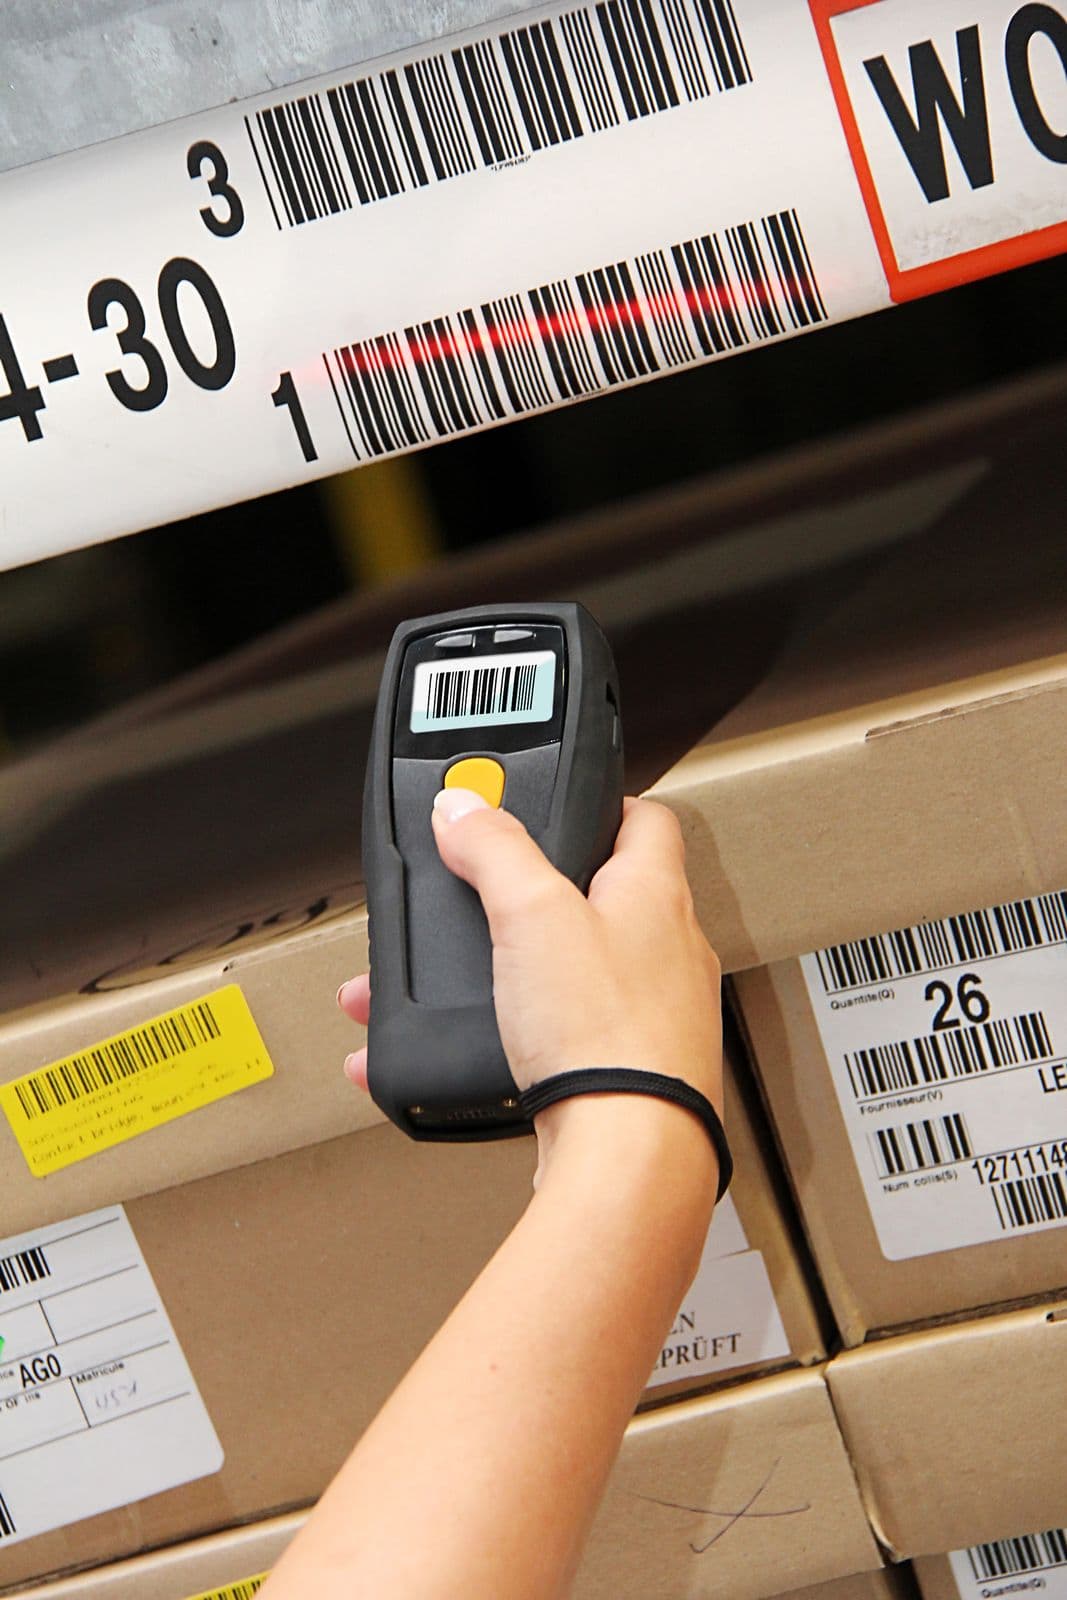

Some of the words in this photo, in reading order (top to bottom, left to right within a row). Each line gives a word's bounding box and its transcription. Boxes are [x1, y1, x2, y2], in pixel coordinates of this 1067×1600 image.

[863, 3, 1067, 204] WO
[188, 141, 245, 238] 3
[0, 258, 236, 441] 4-30
[272, 371, 319, 462] 1
[925, 973, 990, 1031] 26
[859, 1089, 943, 1115] Fournisseur(V)
[883, 1181, 909, 1193] Num
[671, 1311, 696, 1334] N
[75, 1361, 125, 1385] Matricule
[654, 1331, 742, 1370] PRÜFT
